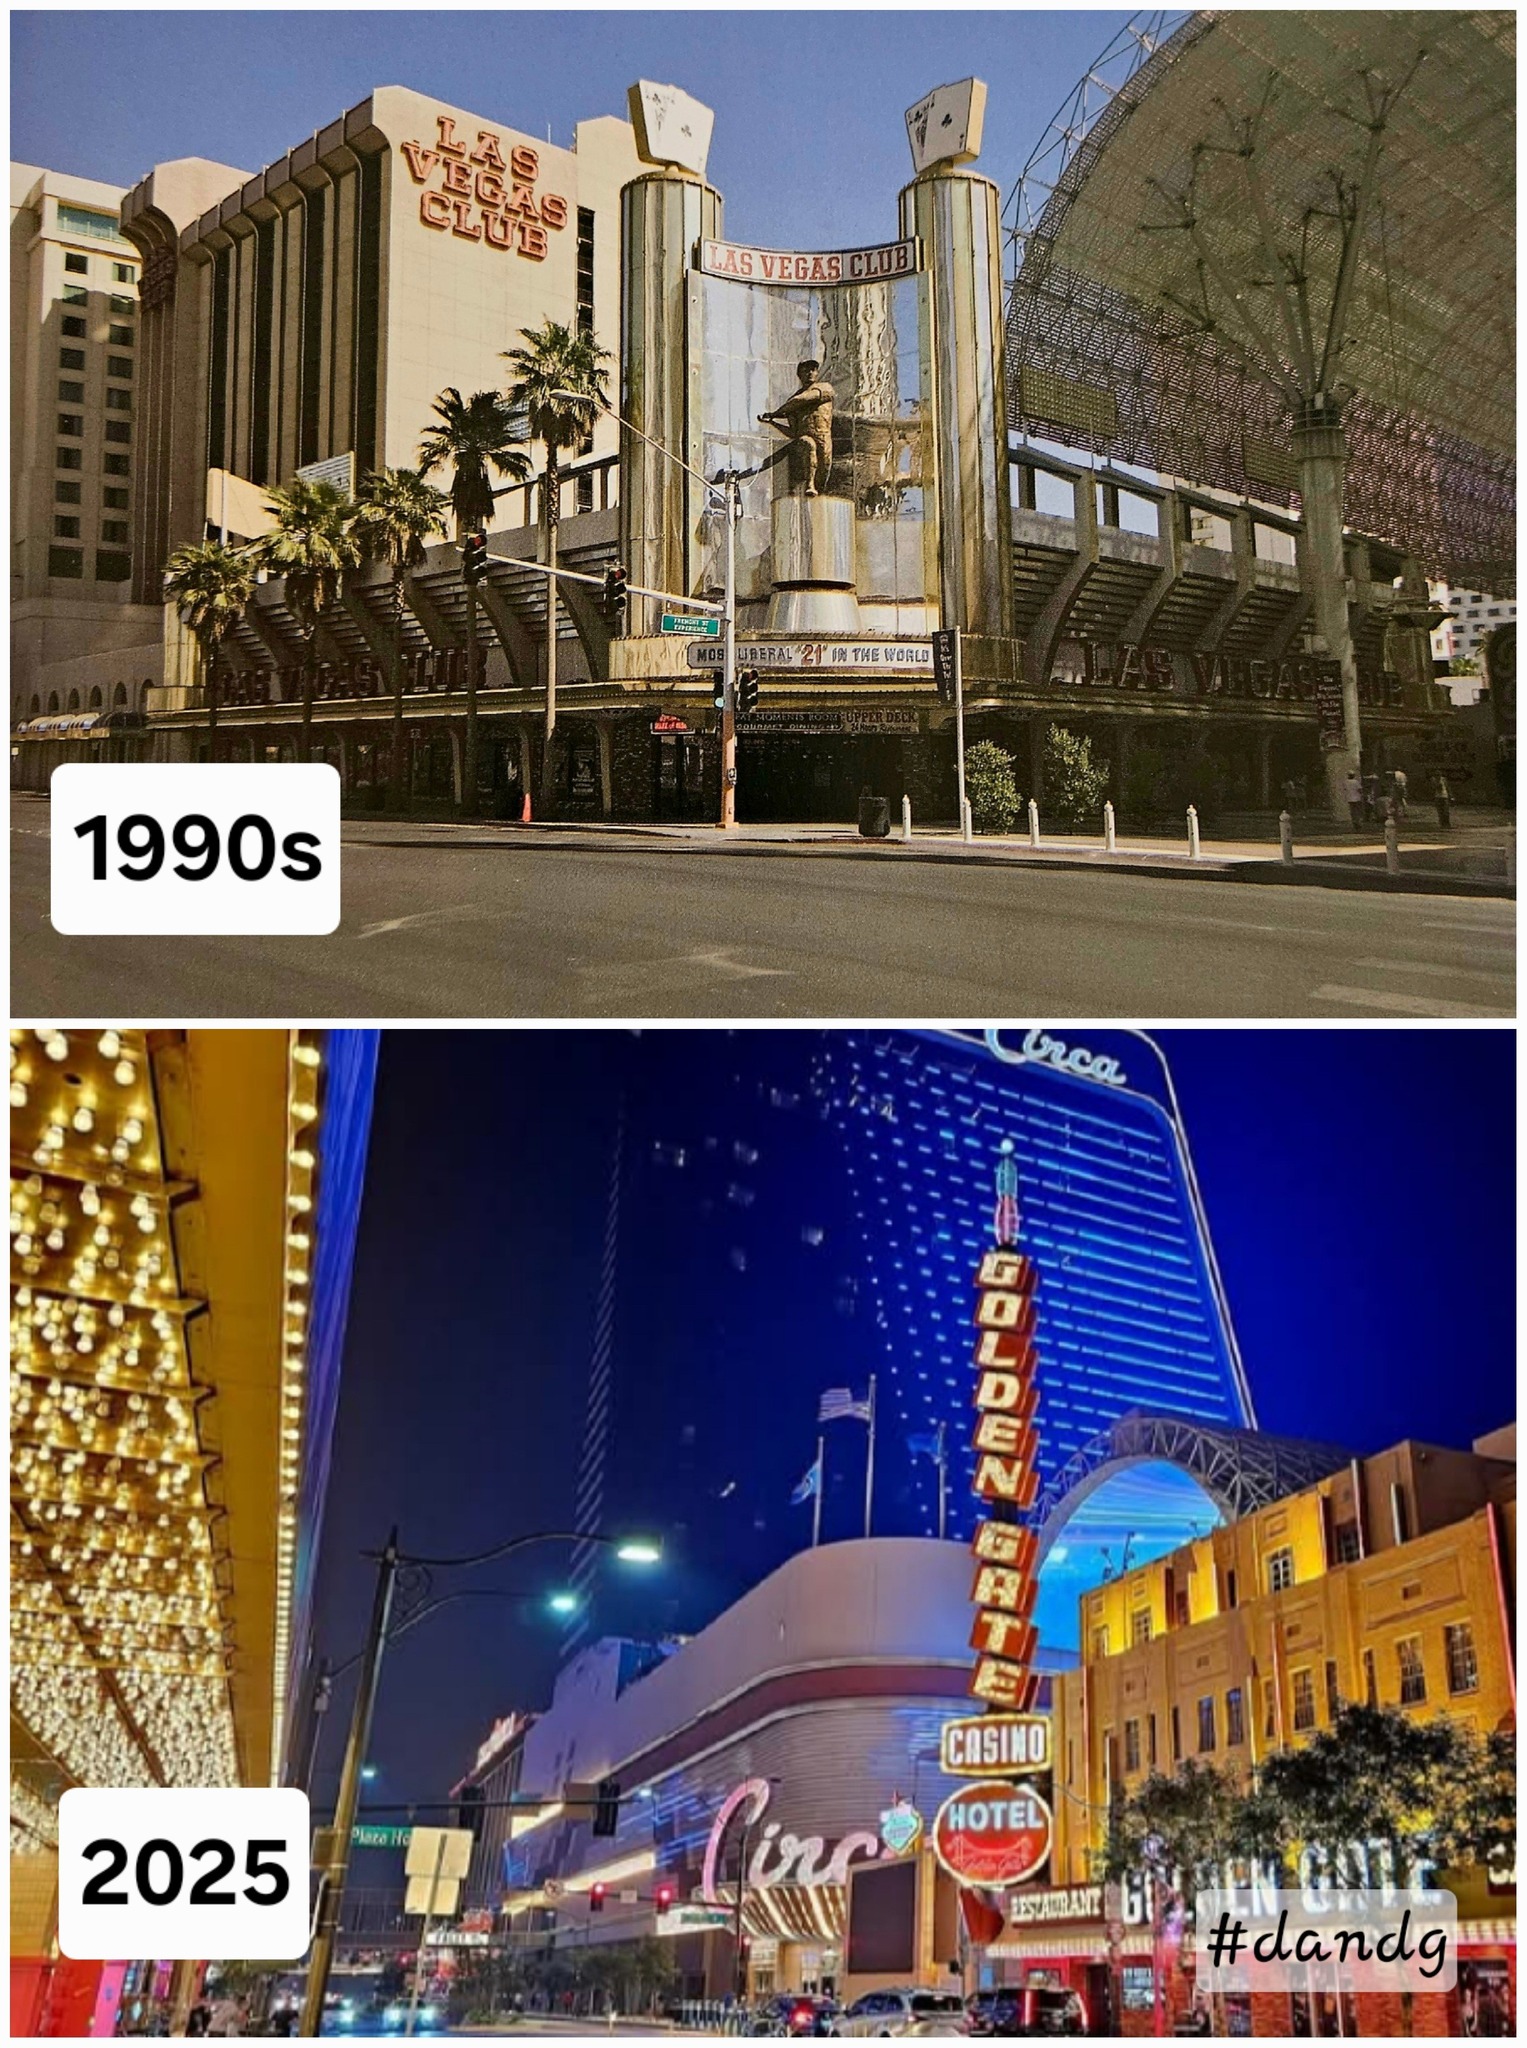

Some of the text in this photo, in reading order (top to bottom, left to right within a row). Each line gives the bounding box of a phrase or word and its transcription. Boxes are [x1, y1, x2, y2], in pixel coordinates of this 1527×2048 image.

[436, 115, 540, 183] LAS
[400, 140, 568, 231] VEGAS
[420, 189, 548, 261] CLUB
[709, 245, 909, 281] LAS VEGAS CLUB
[696, 648, 725, 662] MOS
[737, 647, 793, 662] LIBERAL
[832, 648, 848, 662] IN
[852, 648, 880, 662] THE
[884, 648, 930, 663] WORLD
[1085, 640, 1174, 691] LAS
[1192, 651, 1315, 701] VEGAS
[757, 713, 804, 722] MOMENTS
[809, 713, 837, 722] ROOM
[846, 711, 917, 723] UPPER DECK
[975, 1253, 1024, 1499] GOLDEN
[972, 1522, 1024, 1702] GATE
[949, 1723, 1046, 1767] CASINO
[702, 1778, 879, 1902] Circ
[948, 1799, 1044, 1832] HOTEL
[1011, 1887, 1102, 1922] RESTAURANT
